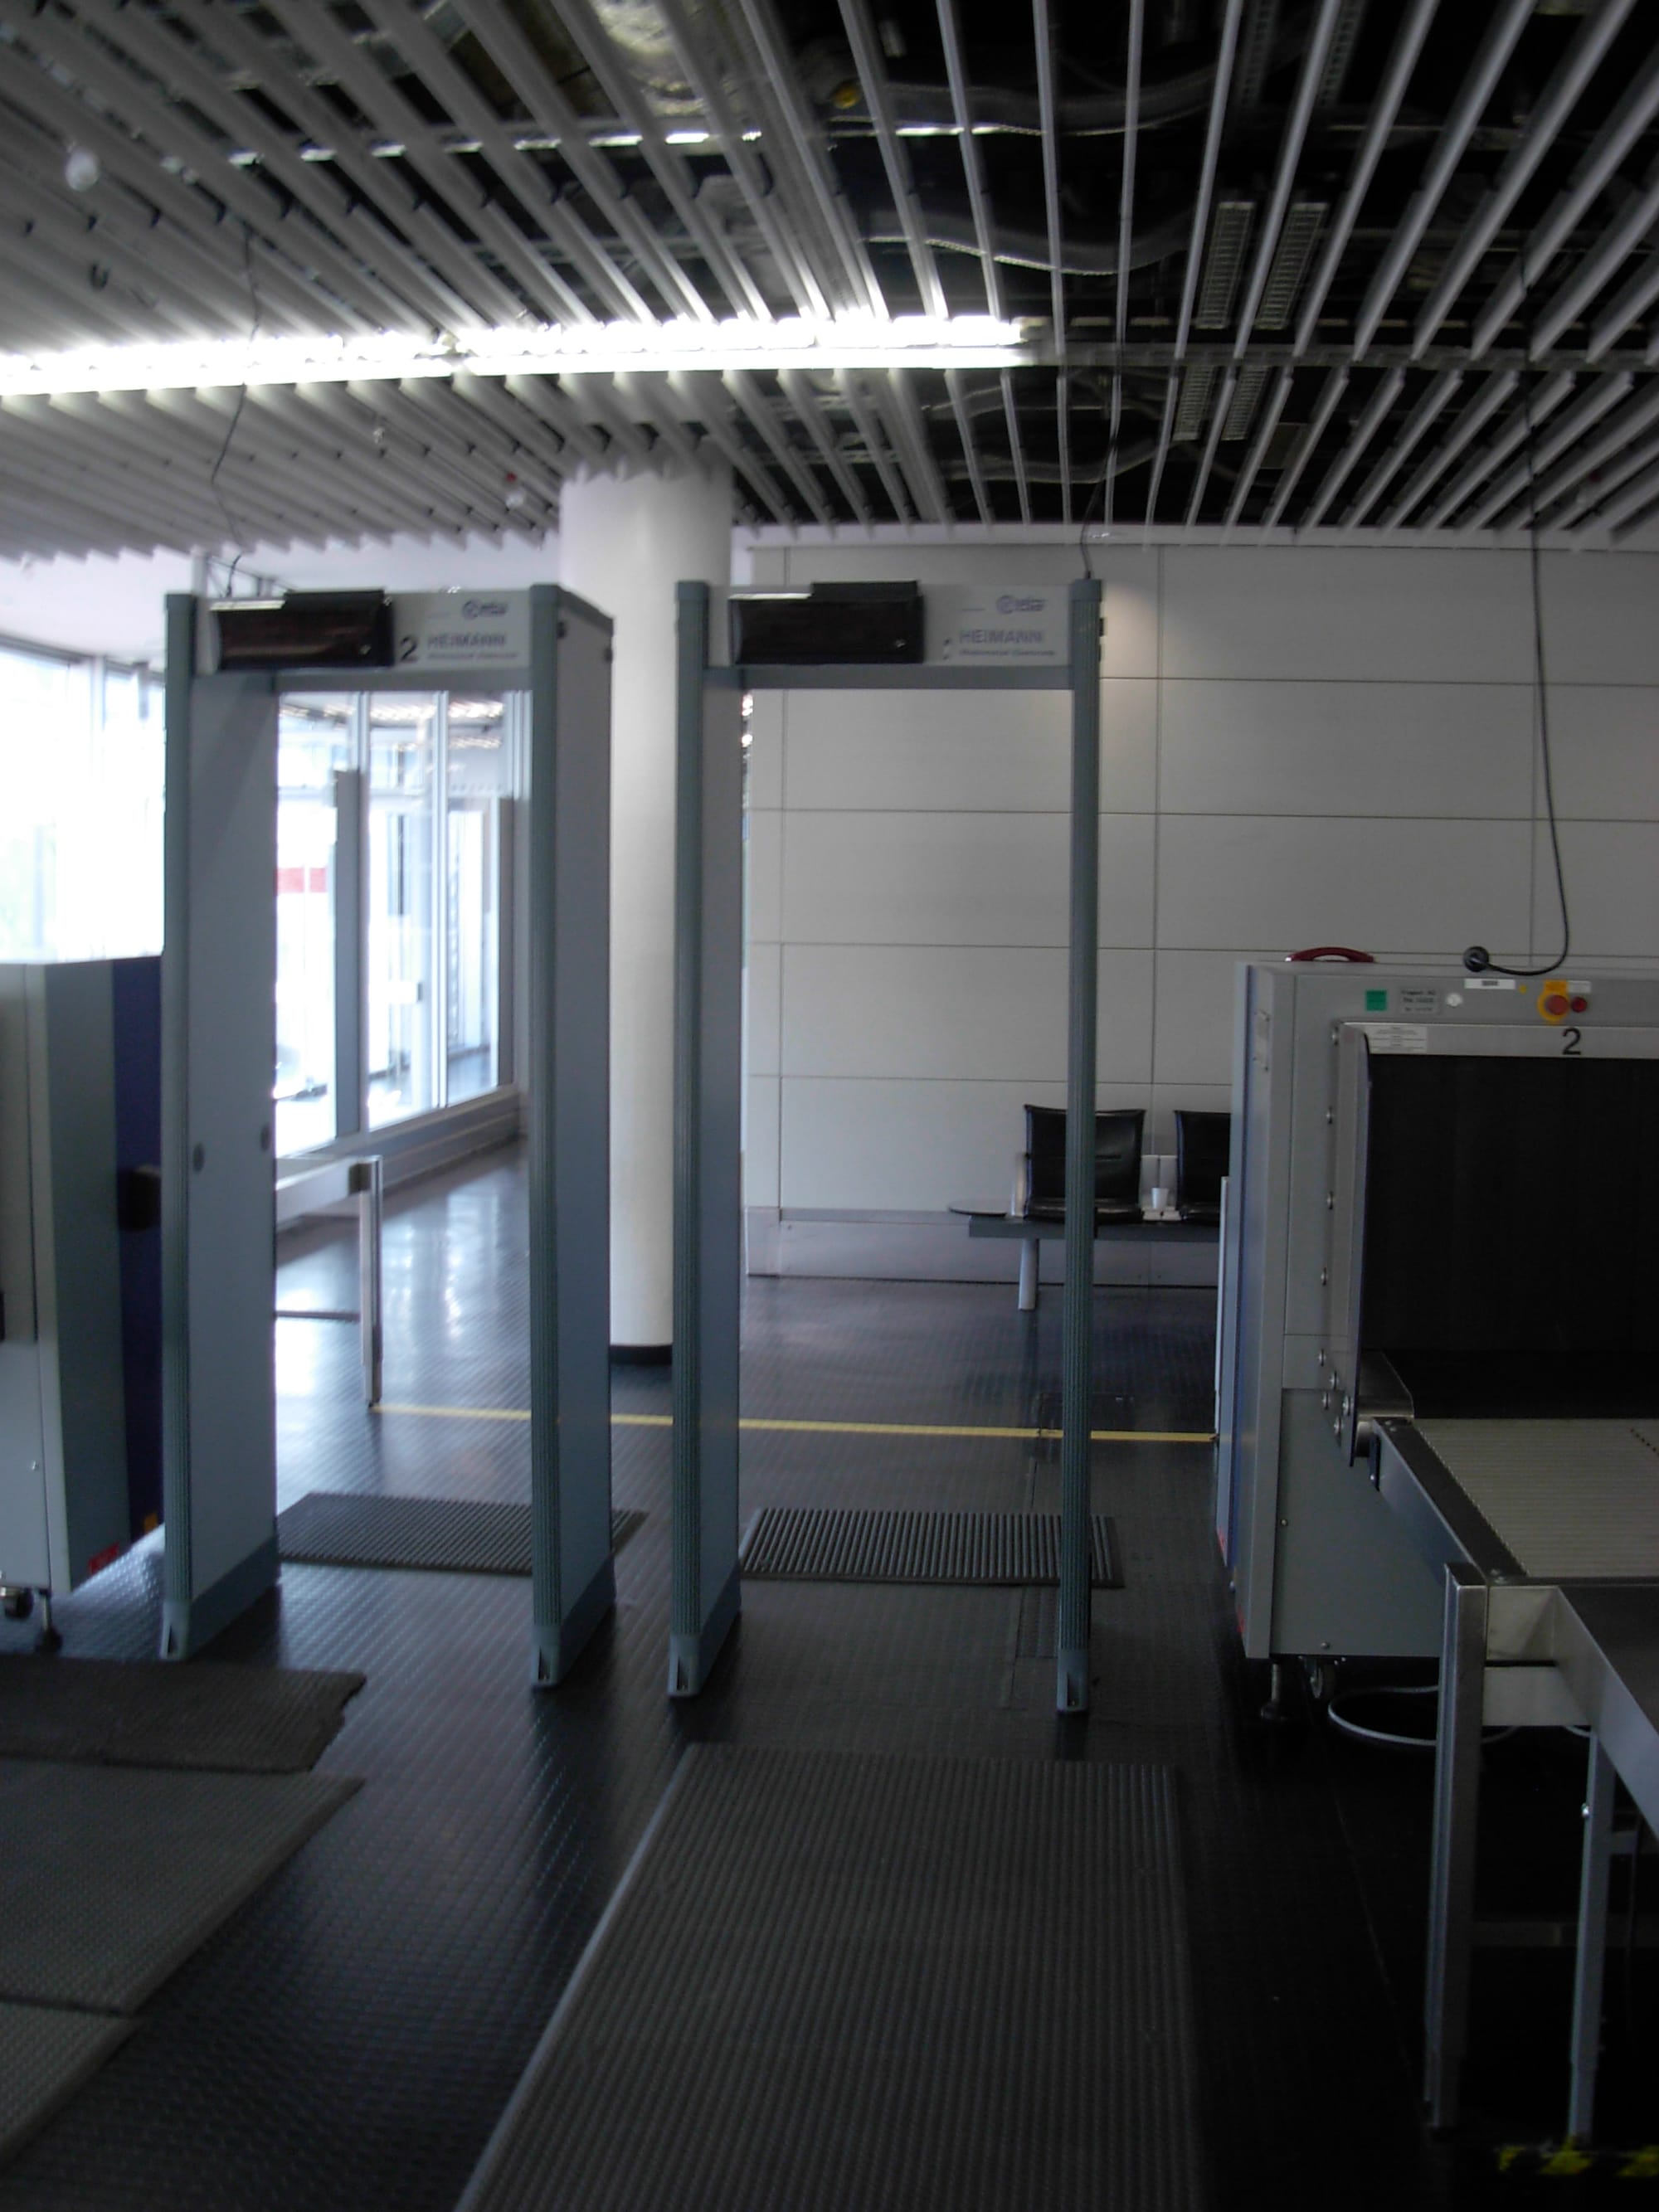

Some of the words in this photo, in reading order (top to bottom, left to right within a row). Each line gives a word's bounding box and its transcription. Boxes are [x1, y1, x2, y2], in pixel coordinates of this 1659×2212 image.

[400, 635, 419, 663] 2
[959, 630, 1044, 644] HEIMANN
[1562, 1028, 1582, 1055] 2
